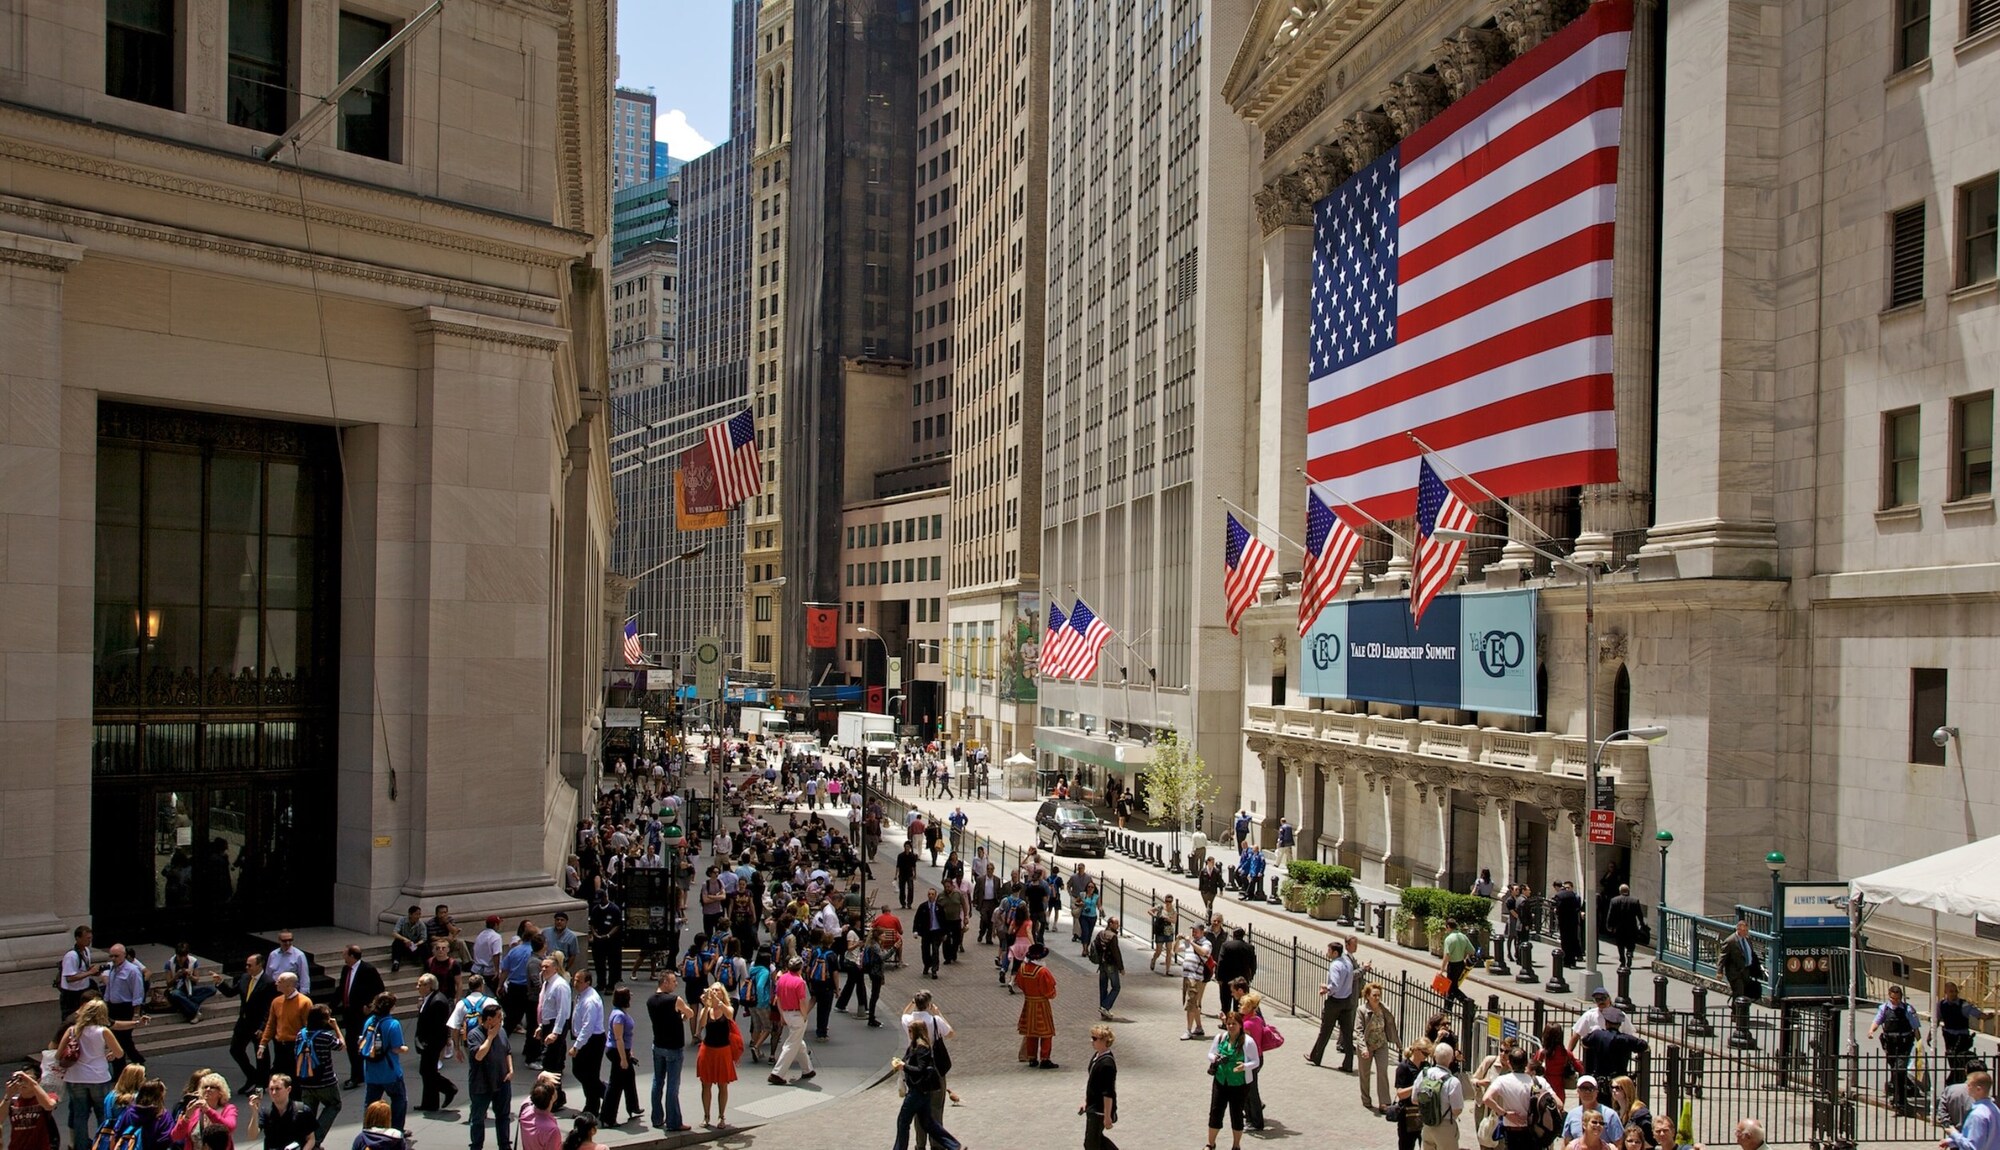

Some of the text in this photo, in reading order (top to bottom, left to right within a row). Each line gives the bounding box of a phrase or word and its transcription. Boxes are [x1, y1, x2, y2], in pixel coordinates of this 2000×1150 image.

[1367, 642, 1381, 658] CEO
[1382, 643, 1424, 659] LEADERSHIP
[1425, 643, 1456, 660] SUMMIT
[1479, 630, 1525, 678] CEO
[1597, 813, 1607, 821] NO
[1794, 896, 1815, 904] ALWAYS
[1696, 924, 1720, 941] Subway
